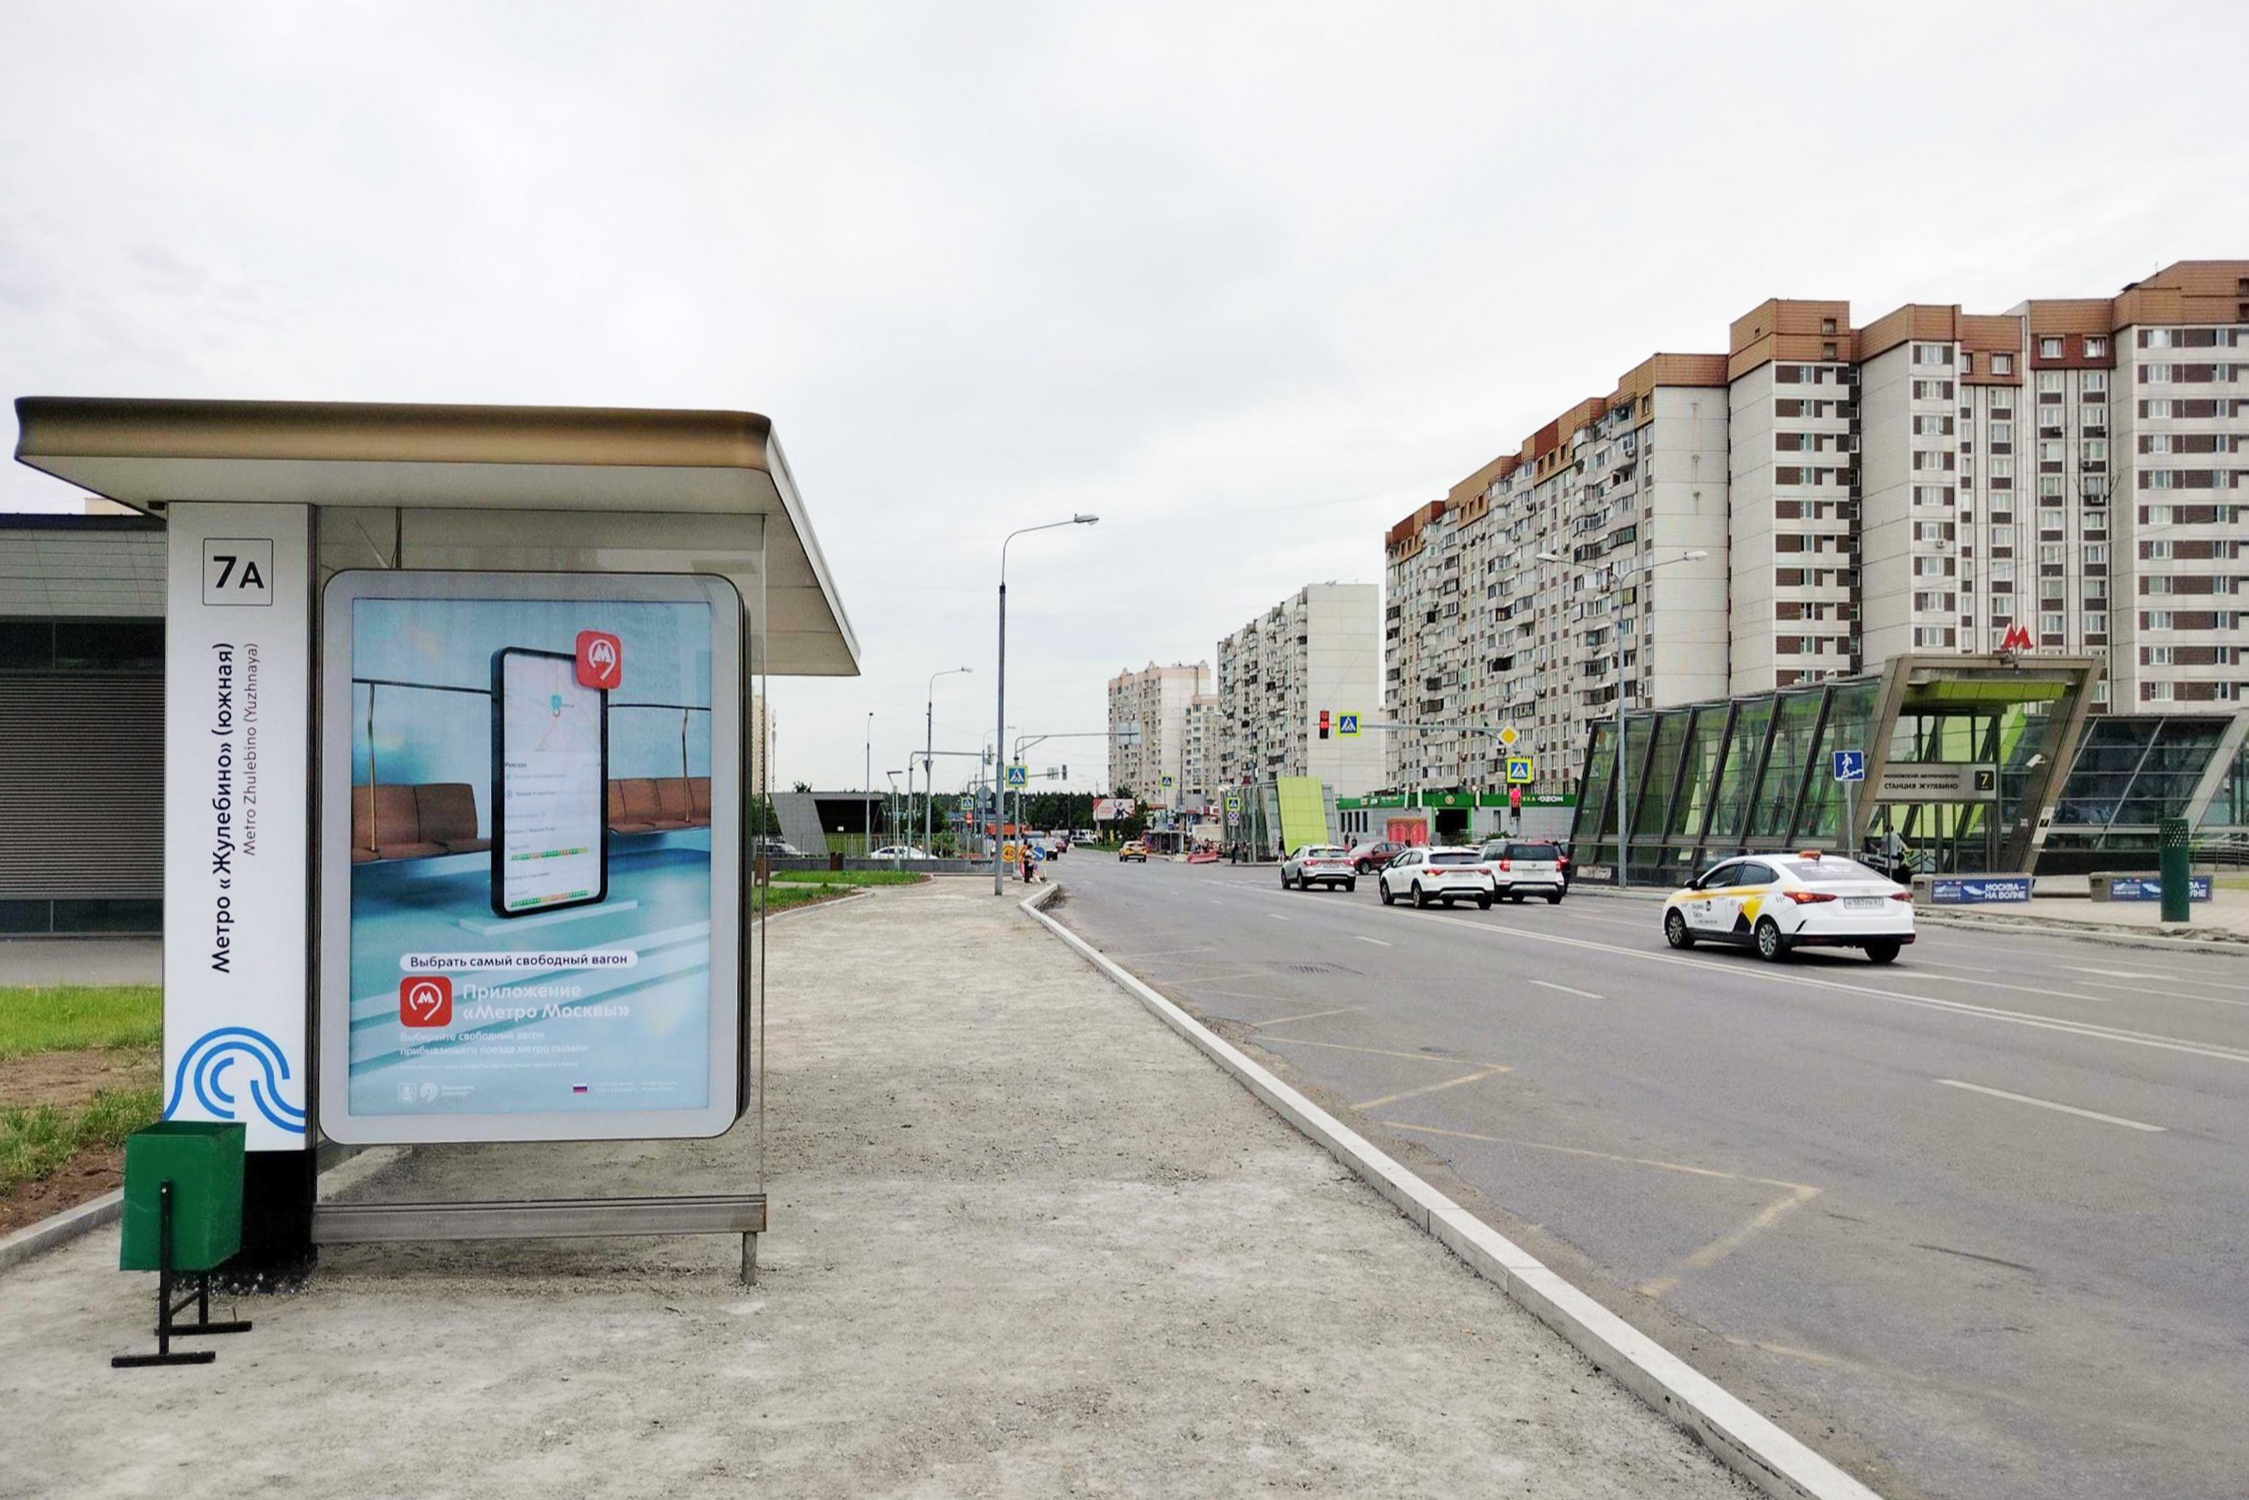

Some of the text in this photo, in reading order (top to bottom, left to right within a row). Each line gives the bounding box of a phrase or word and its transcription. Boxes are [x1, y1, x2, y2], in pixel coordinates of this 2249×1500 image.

[211, 643, 235, 736] (южная)
[243, 643, 260, 857] Metro Zhulebino (Yuzhnaya)
[1884, 782, 1959, 791] СТАНЦИЯ ЖУЛЕБИНО
[1980, 773, 1990, 786] 7
[1984, 883, 2019, 892] МОСКВА
[211, 896, 235, 974] Метро
[410, 953, 628, 969] Выбрать самый свободный вагон
[463, 984, 582, 1001] Приложение
[462, 1003, 630, 1022] «Метро Москвы»
